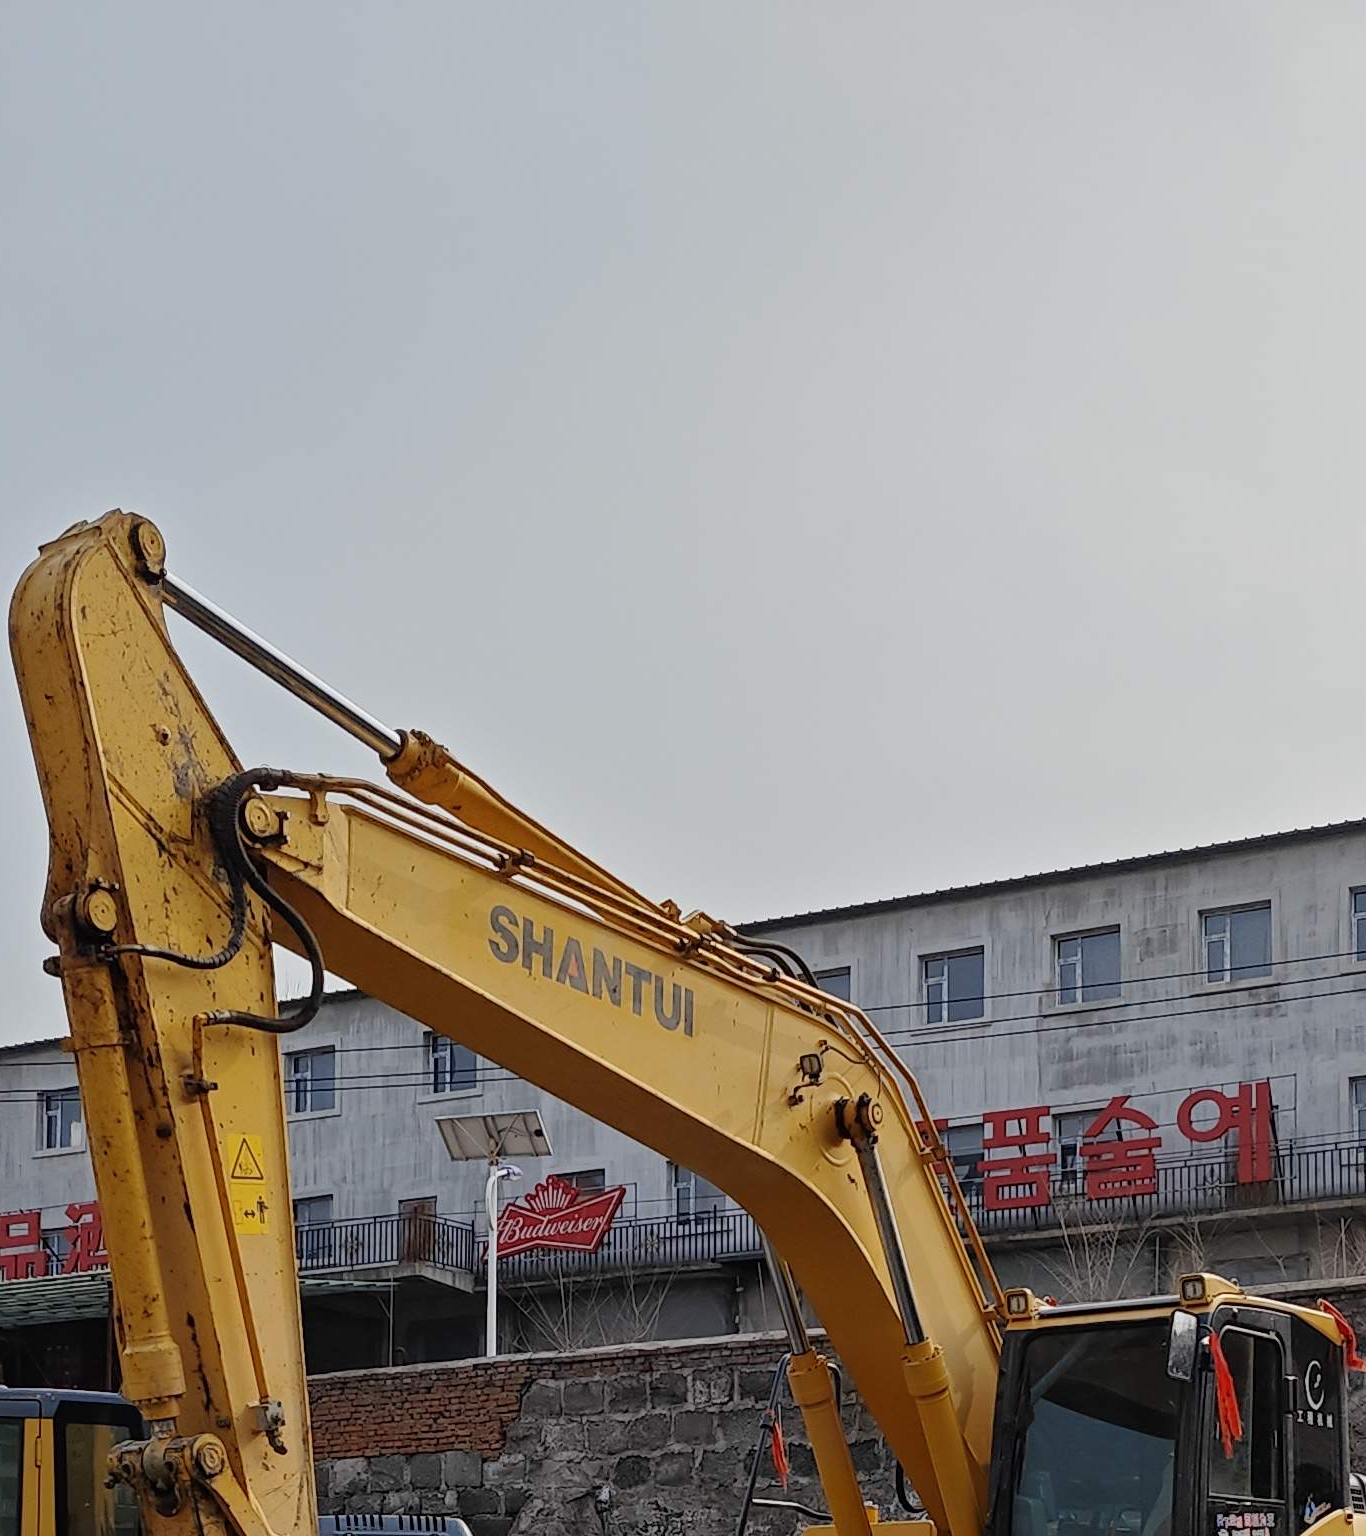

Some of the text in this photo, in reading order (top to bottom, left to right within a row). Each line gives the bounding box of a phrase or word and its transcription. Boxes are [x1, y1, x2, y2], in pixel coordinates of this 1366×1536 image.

[488, 904, 695, 1038] SHANTUI
[915, 1081, 1272, 1211] 품술예
[497, 1213, 604, 1244] Budweiser
